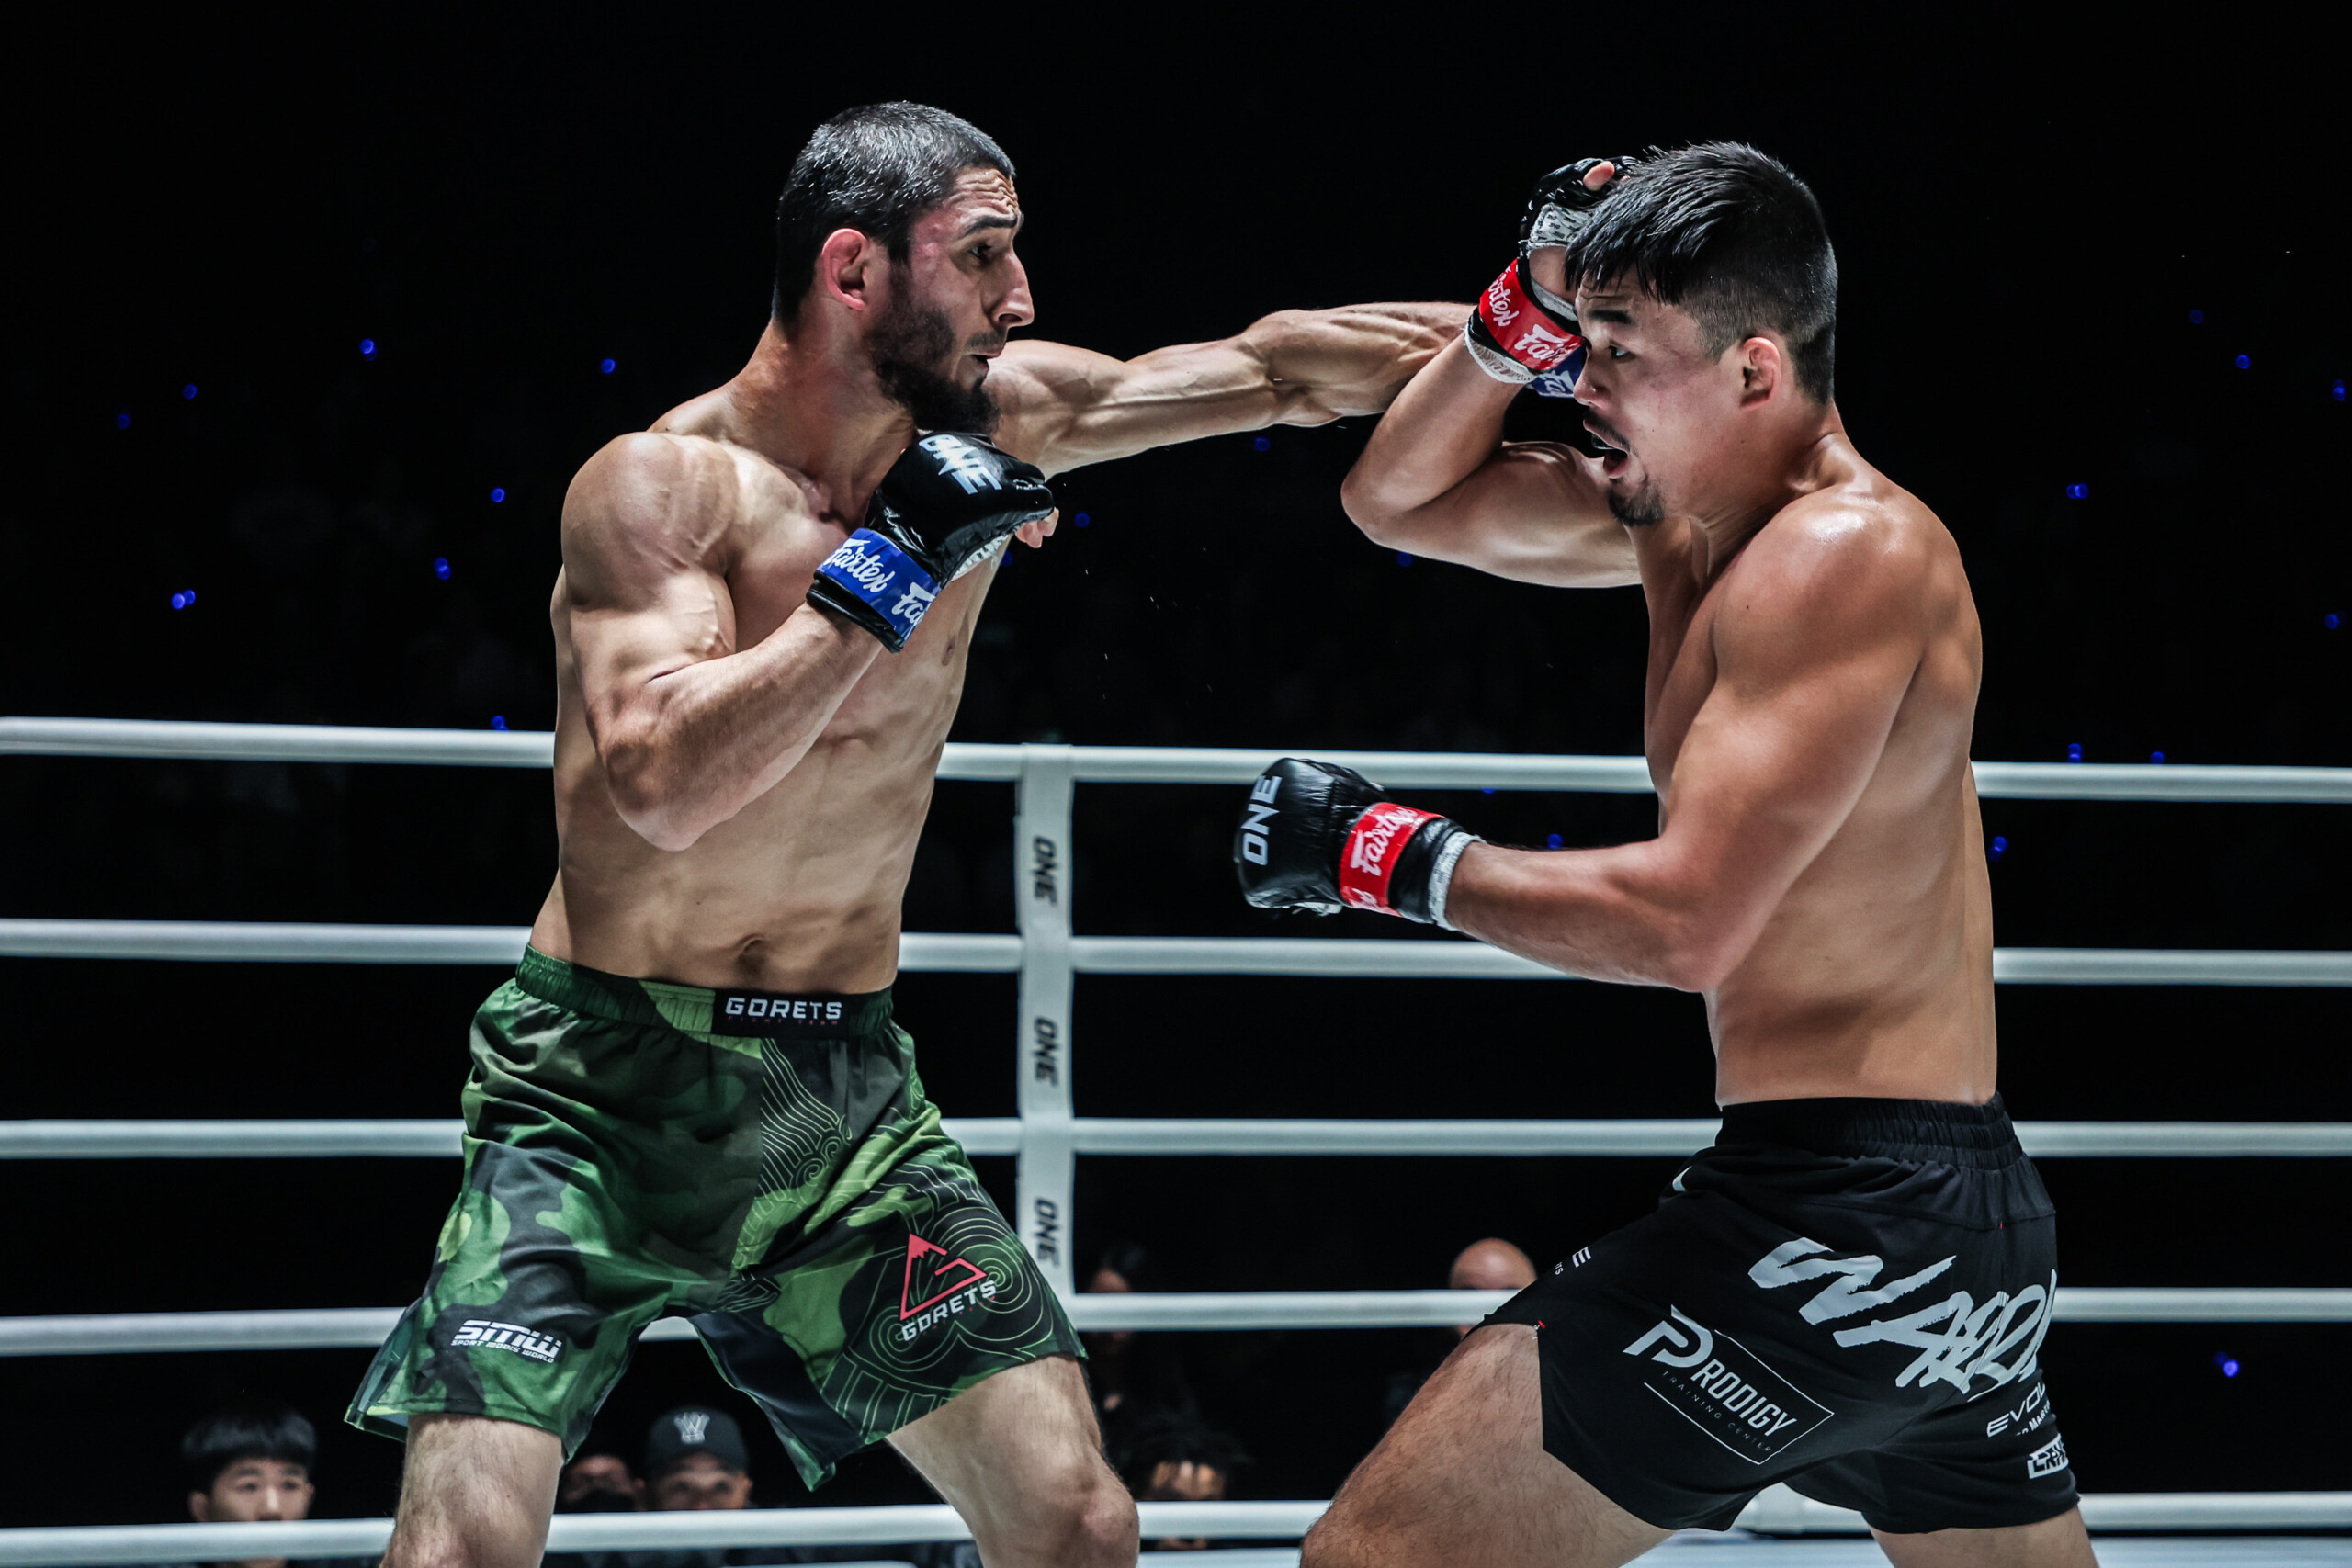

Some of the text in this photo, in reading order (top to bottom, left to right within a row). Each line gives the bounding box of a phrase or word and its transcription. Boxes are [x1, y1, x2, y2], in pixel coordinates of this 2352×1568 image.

[1241, 775, 1283, 866] ONE
[1030, 835, 1058, 905] ONE
[725, 997, 842, 1020] GORETS
[1032, 1016, 1060, 1086] ONE
[1033, 1198, 1061, 1266] ONE
[901, 1280, 997, 1342] GORETS
[521, 1349, 555, 1364] WORLD
[1623, 1304, 1797, 1437] PRODIGY
[1662, 1371, 1771, 1452] TRAINING CENTER
[1987, 1382, 2046, 1438] EVOL
